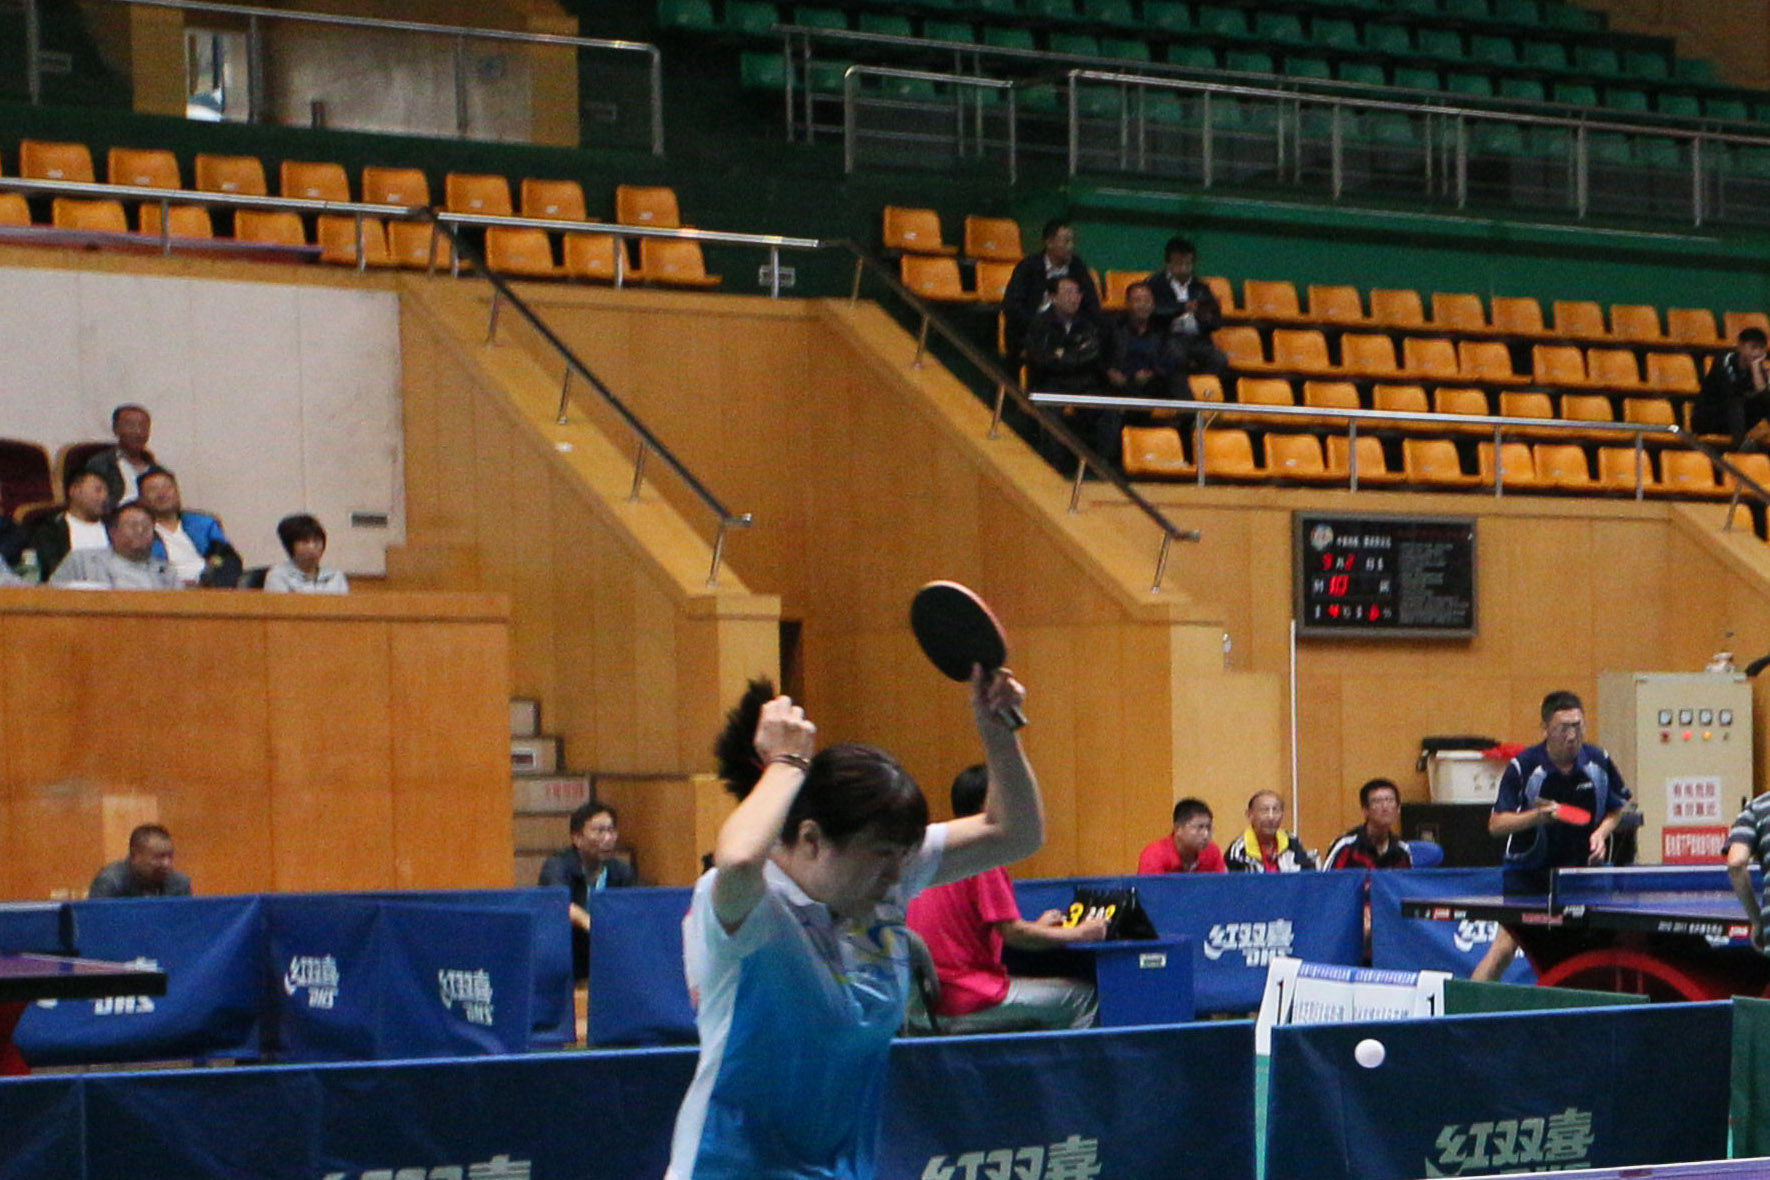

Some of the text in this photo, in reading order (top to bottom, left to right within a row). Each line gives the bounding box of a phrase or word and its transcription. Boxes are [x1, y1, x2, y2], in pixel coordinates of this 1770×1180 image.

[1203, 918, 1295, 960] 红双喜
[1424, 1106, 1596, 1179] 红双喜
